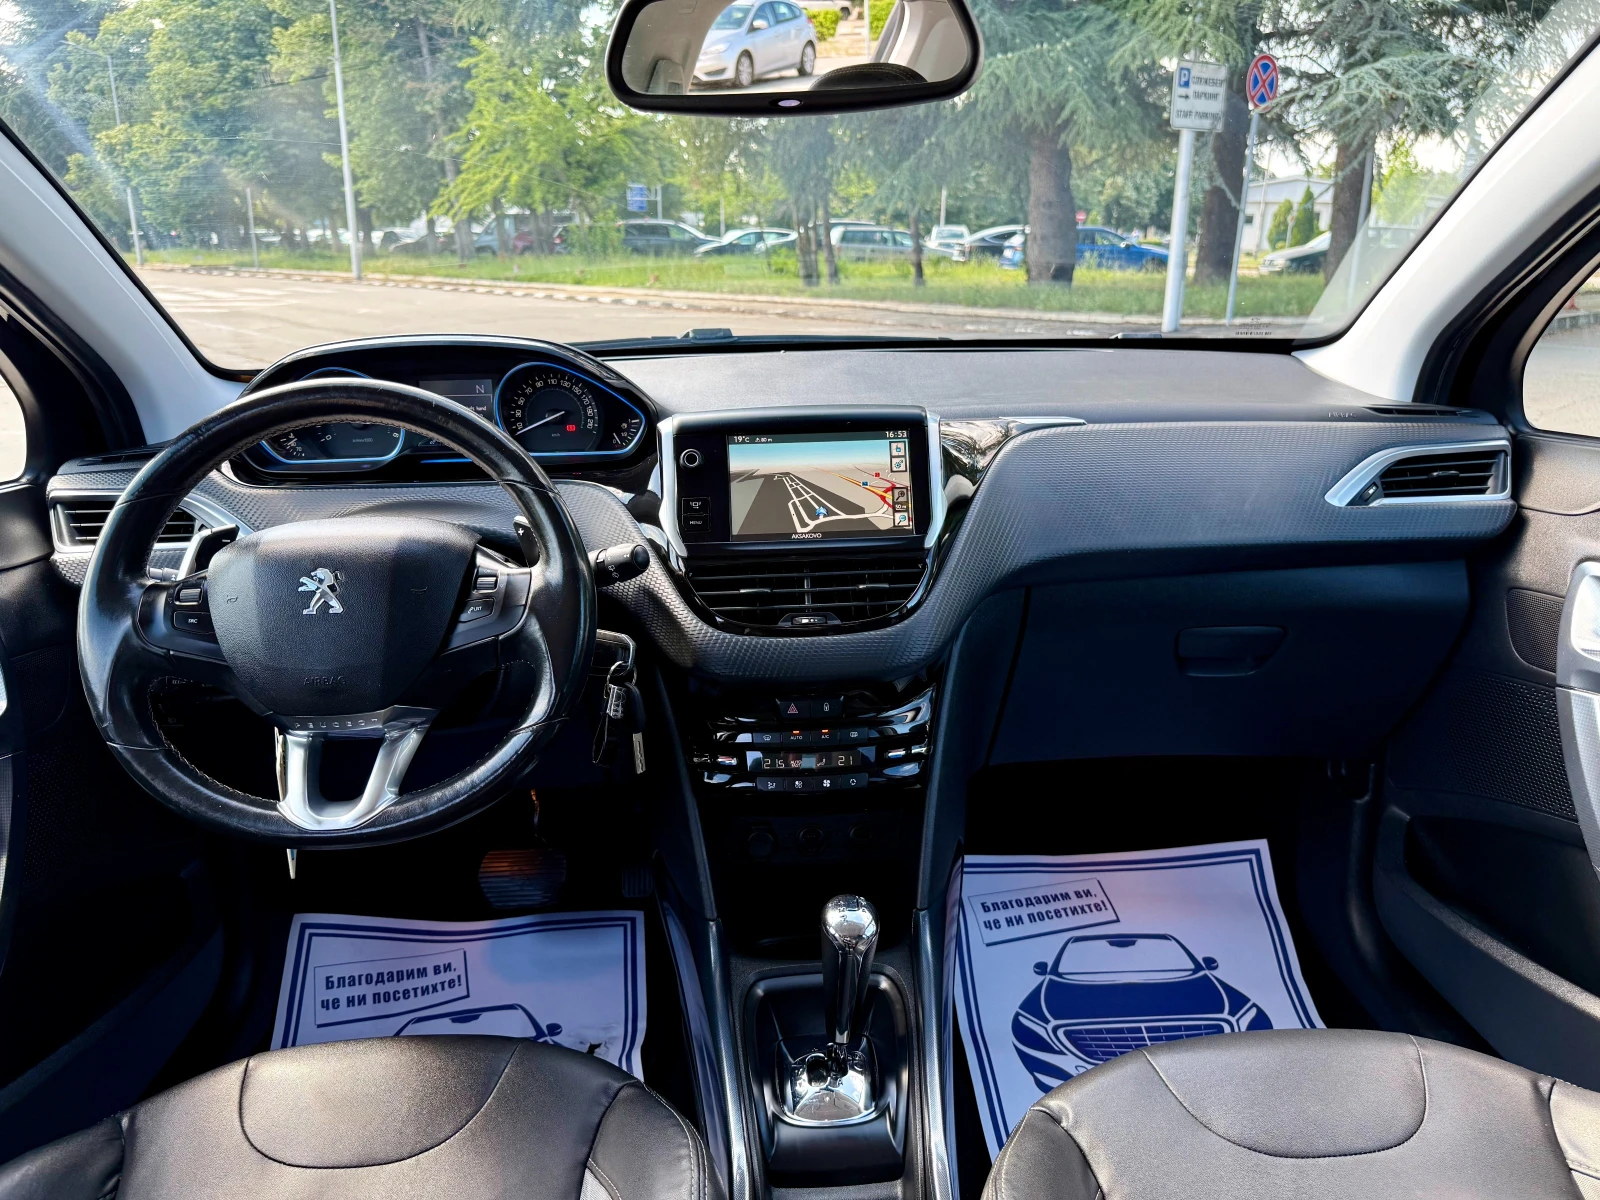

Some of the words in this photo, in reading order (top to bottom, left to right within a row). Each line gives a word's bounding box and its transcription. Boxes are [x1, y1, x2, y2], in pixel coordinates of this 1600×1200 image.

[475, 384, 485, 394] N
[560, 380, 571, 388] 130
[525, 387, 533, 395] 70
[571, 385, 582, 395] 150
[580, 394, 590, 405] 170
[516, 409, 522, 418] 30
[294, 718, 378, 729] PEUGEOT
[980, 891, 1072, 913] Благодарим
[983, 918, 1001, 930] че
[1005, 914, 1024, 928] ни
[1027, 900, 1108, 924] посетихте!
[325, 966, 428, 990] Благодарим
[321, 997, 340, 1010] че
[346, 993, 367, 1008] ни
[372, 974, 462, 1005] посетихте!
